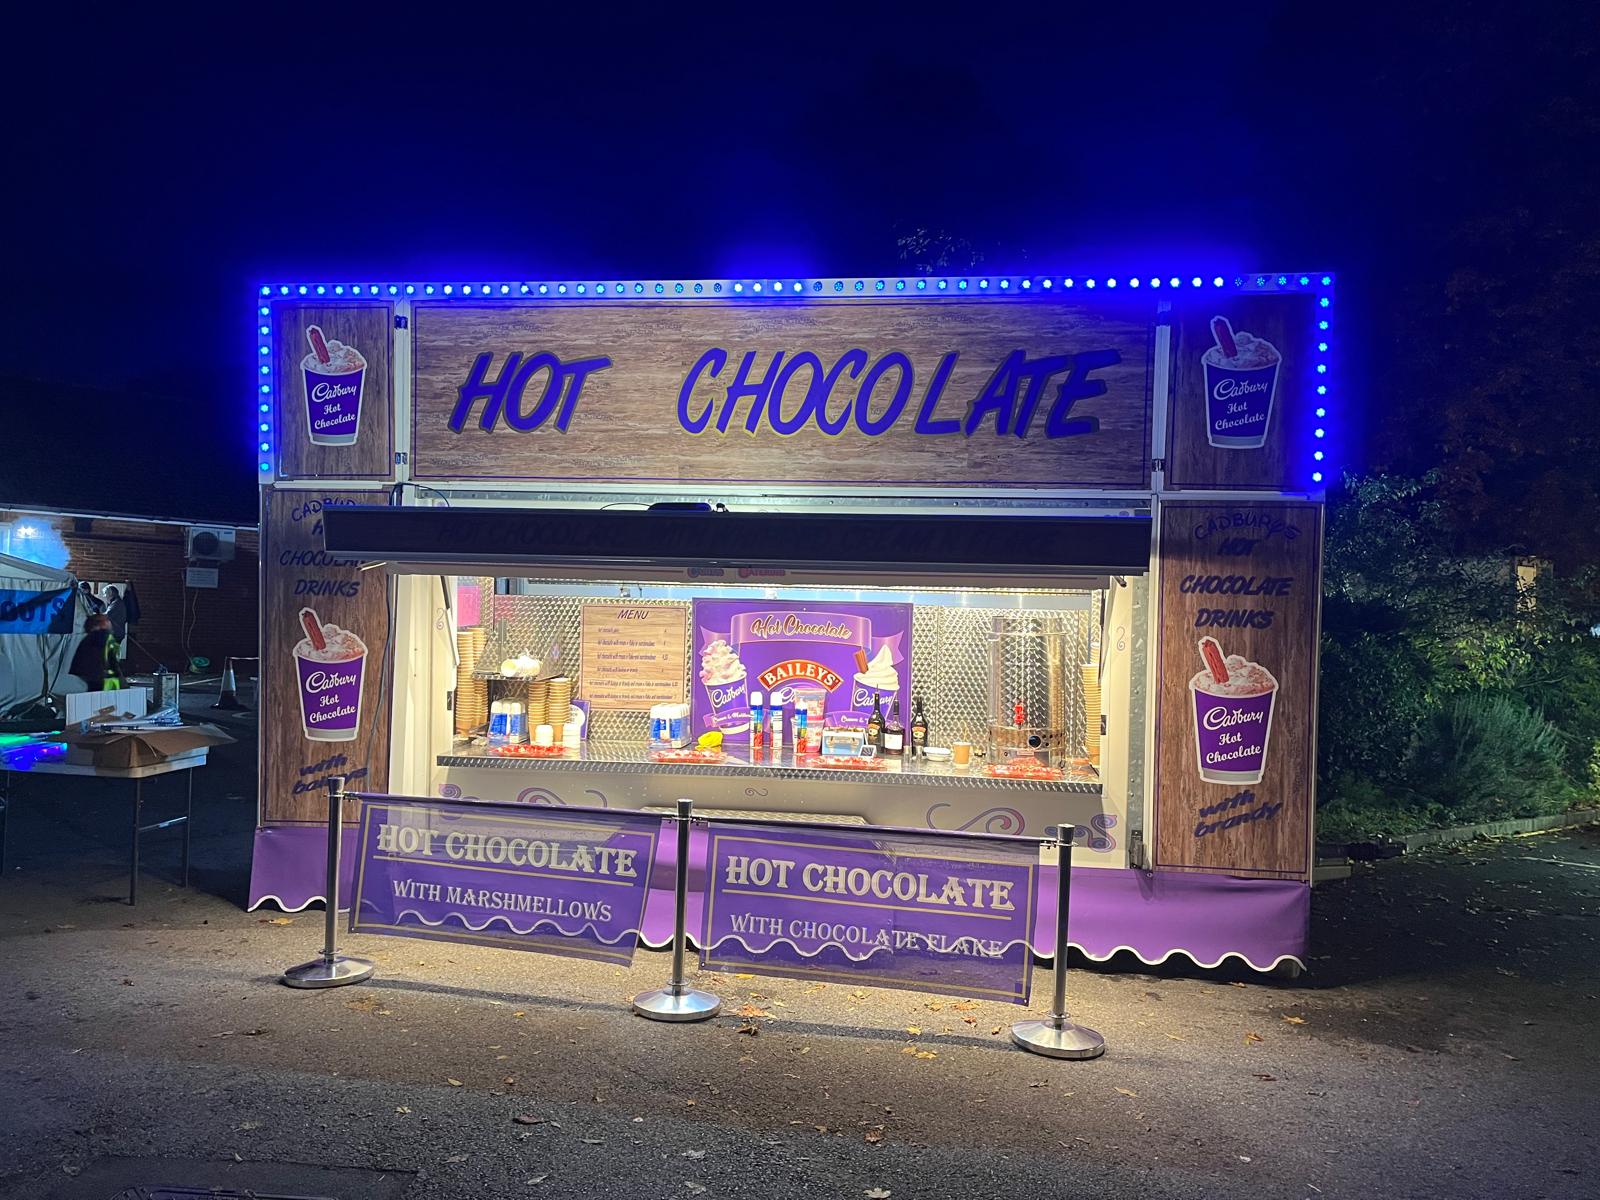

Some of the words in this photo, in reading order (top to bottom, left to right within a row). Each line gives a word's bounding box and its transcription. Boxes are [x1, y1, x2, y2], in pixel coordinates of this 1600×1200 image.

[311, 382, 358, 402] Cadbury
[446, 350, 613, 434] HOT
[677, 347, 1122, 439] CHOCOLATE
[1213, 378, 1269, 400] Cadbury
[323, 403, 342, 415] Hot
[1226, 402, 1248, 414] Hot
[314, 412, 356, 430] Chocolate
[1215, 412, 1265, 430] Chocolate
[1217, 536, 1261, 556] HOT
[294, 579, 360, 598] DRINKS
[1180, 575, 1295, 596] CHOCOLATE
[617, 609, 649, 620] MENU
[1194, 607, 1276, 630] DRINKS
[750, 614, 783, 639] Hot
[783, 613, 853, 640] Chocolate
[305, 671, 357, 693] Cadbury
[763, 662, 837, 686] BAILEYS
[320, 694, 340, 707] Hot
[309, 705, 357, 723] Chocolate
[1203, 706, 1264, 730] Cadbury
[1218, 731, 1243, 745] Hot
[1206, 744, 1262, 764] Chocolate
[376, 823, 439, 857] HOT
[445, 831, 638, 878] CHOCOLATE
[725, 855, 796, 888] HOT
[802, 863, 1017, 911] CHOCOLATE
[393, 878, 441, 901] WITH
[447, 885, 613, 922] MARSHMELLOWS
[730, 912, 783, 936] WITH
[789, 919, 920, 950] CHOCOLATE
[927, 933, 1004, 960] FLAKE
